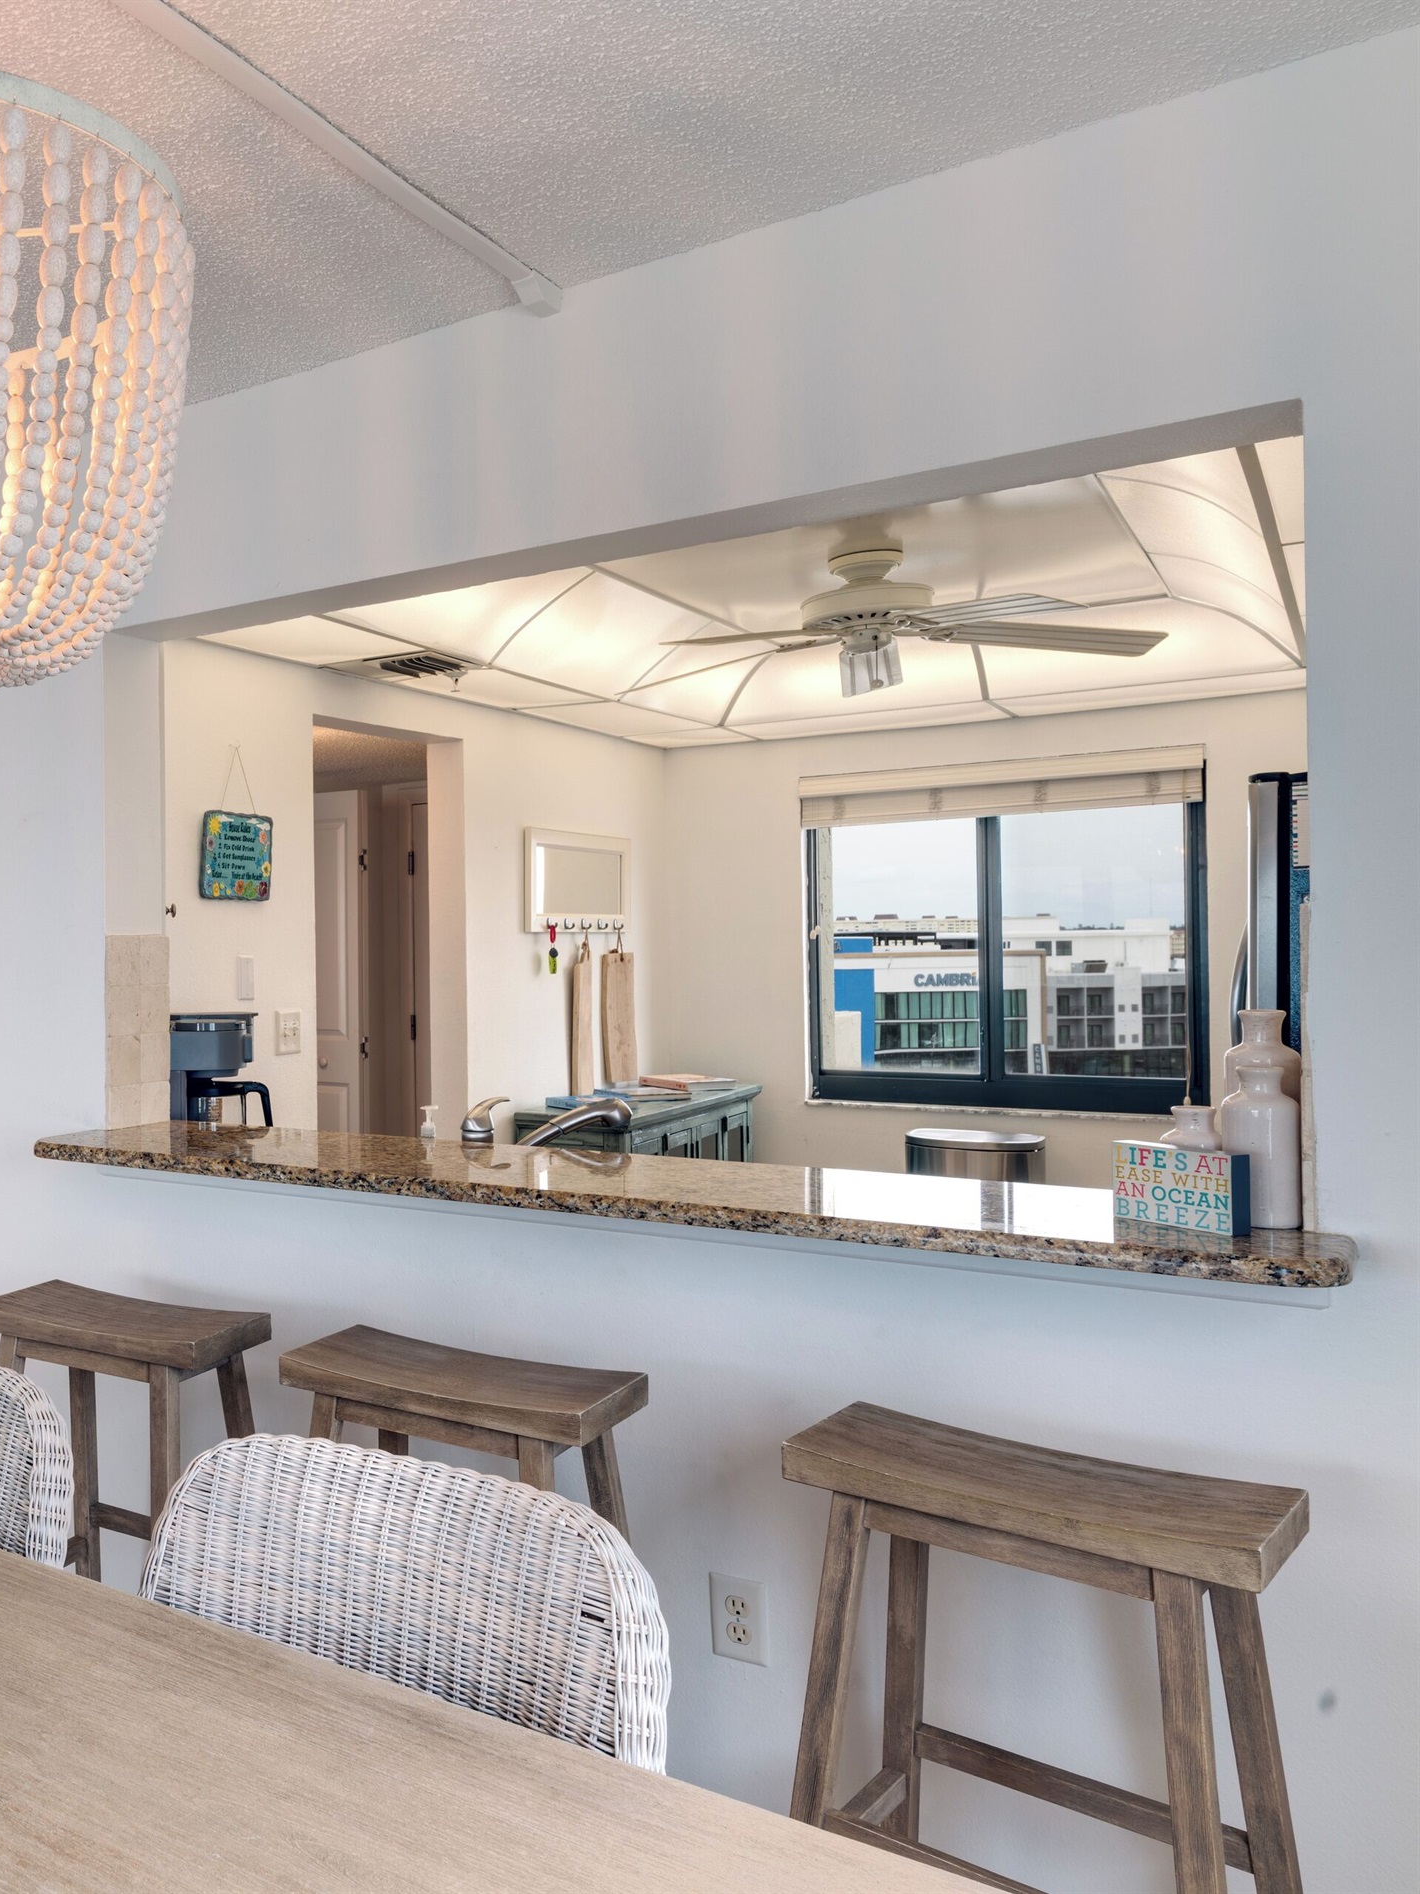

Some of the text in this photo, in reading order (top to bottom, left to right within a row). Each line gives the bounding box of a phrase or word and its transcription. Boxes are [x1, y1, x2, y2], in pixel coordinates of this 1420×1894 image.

[224, 834, 242, 842] Remove
[242, 836, 256, 844] Shoes
[232, 853, 256, 861] Sunglasses
[1115, 1145, 1229, 1176] LIFE'S AT
[1115, 1165, 1229, 1193] EASE WITH
[1115, 1181, 1230, 1211] AN OCEAN
[1115, 1197, 1230, 1233] BREEZE
